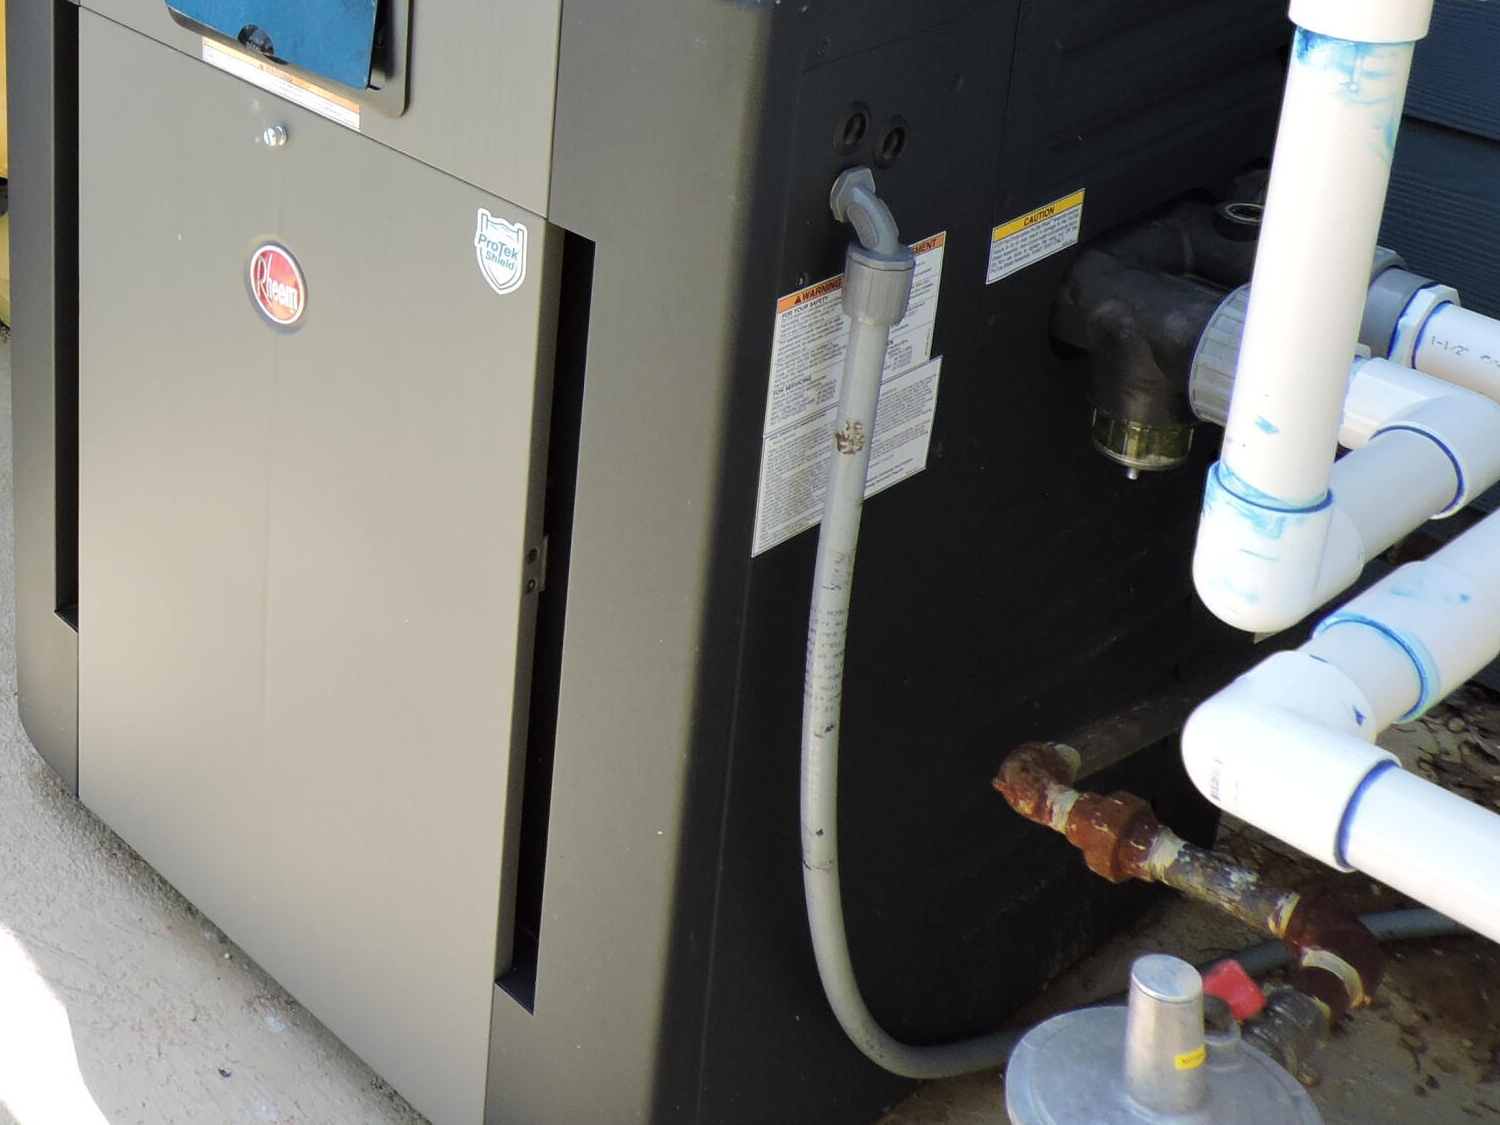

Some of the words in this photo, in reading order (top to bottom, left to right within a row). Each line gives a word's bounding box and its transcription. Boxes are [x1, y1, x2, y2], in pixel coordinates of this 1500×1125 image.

[1023, 206, 1056, 227] CAUTION
[478, 233, 519, 261] ProTek
[485, 250, 515, 271] Shield
[254, 253, 298, 311] Rheem
[809, 296, 829, 308] SAFETY
